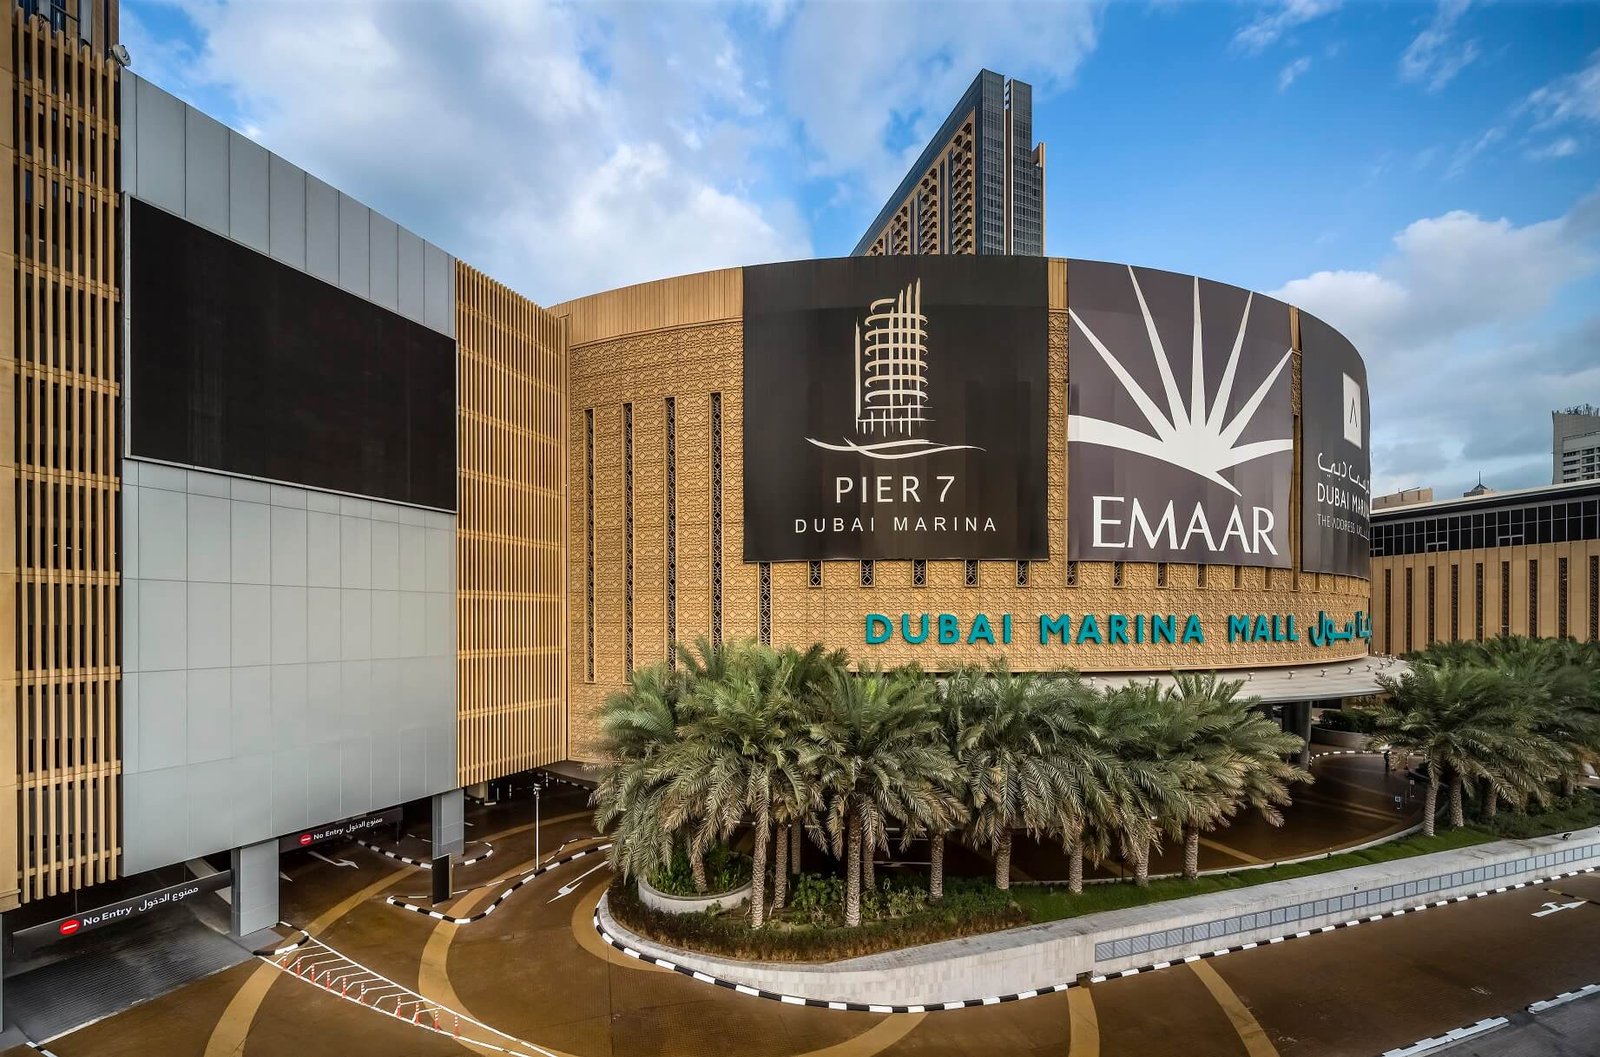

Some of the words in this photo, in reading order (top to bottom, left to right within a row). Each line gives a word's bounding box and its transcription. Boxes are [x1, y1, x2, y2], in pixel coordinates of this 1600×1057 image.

[1317, 452, 1347, 481] دبي
[836, 475, 921, 503] PIER
[936, 475, 955, 503] 7
[1318, 482, 1350, 510] DUBAI
[795, 517, 875, 533] DUBAI
[893, 516, 997, 532] MARINA
[1092, 495, 1279, 556] EMAAR
[1317, 513, 1331, 528] THE
[1331, 517, 1355, 534] ADDRESS
[864, 612, 1012, 645] DUBAI
[1039, 612, 1205, 645] MARINA
[1227, 612, 1300, 642] MALL
[1308, 610, 1354, 647] مول
[345, 820, 366, 833] الدخول
[366, 817, 383, 828] ممنوع
[313, 833, 324, 841] No
[325, 828, 344, 838] Entry
[138, 893, 170, 912] الدخول
[172, 886, 199, 902] ممنوع
[83, 916, 100, 927] No
[101, 906, 133, 921] Entry
